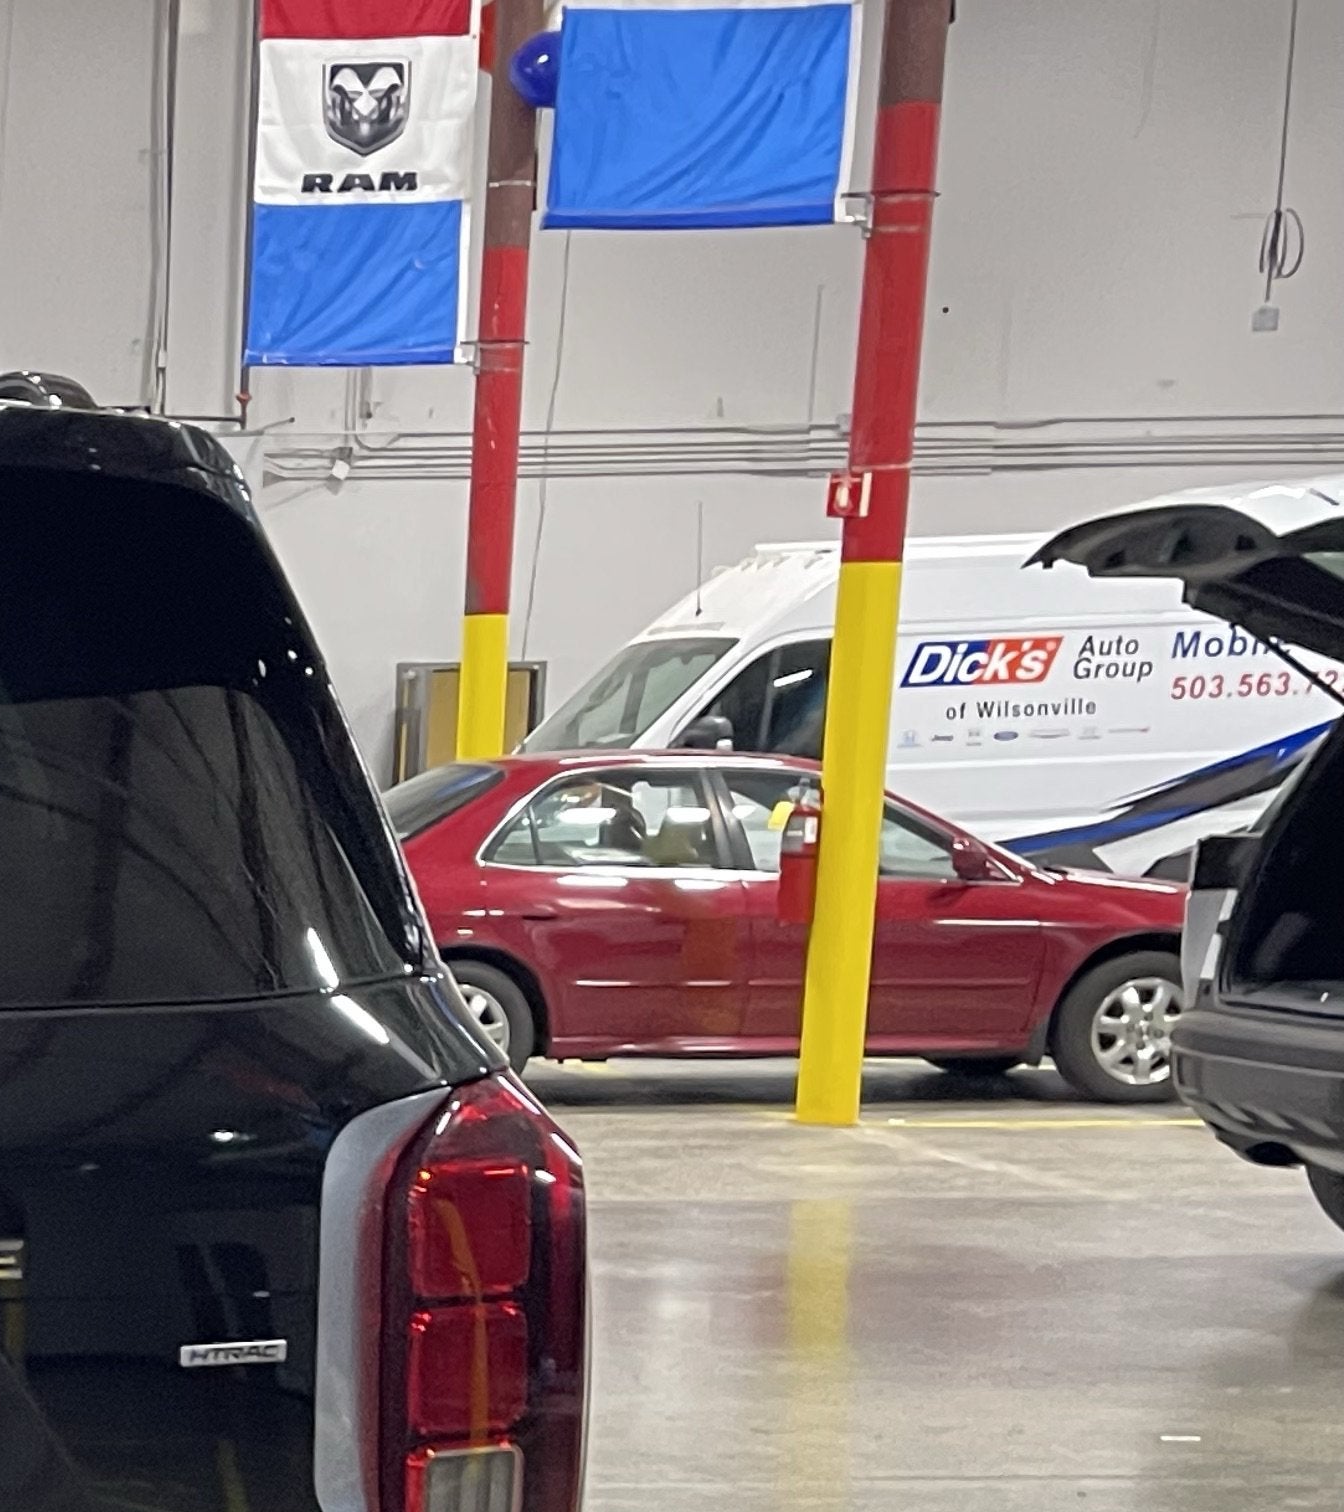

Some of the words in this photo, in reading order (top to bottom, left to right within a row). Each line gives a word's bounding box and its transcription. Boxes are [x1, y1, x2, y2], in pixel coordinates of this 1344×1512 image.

[301, 171, 419, 194] RAM
[1077, 635, 1140, 658] Auto
[1171, 630, 1290, 659] Mobi
[907, 640, 1050, 686] Dick's
[1072, 657, 1154, 684] Group
[945, 702, 966, 721] of
[976, 698, 1097, 720] Wilsonville
